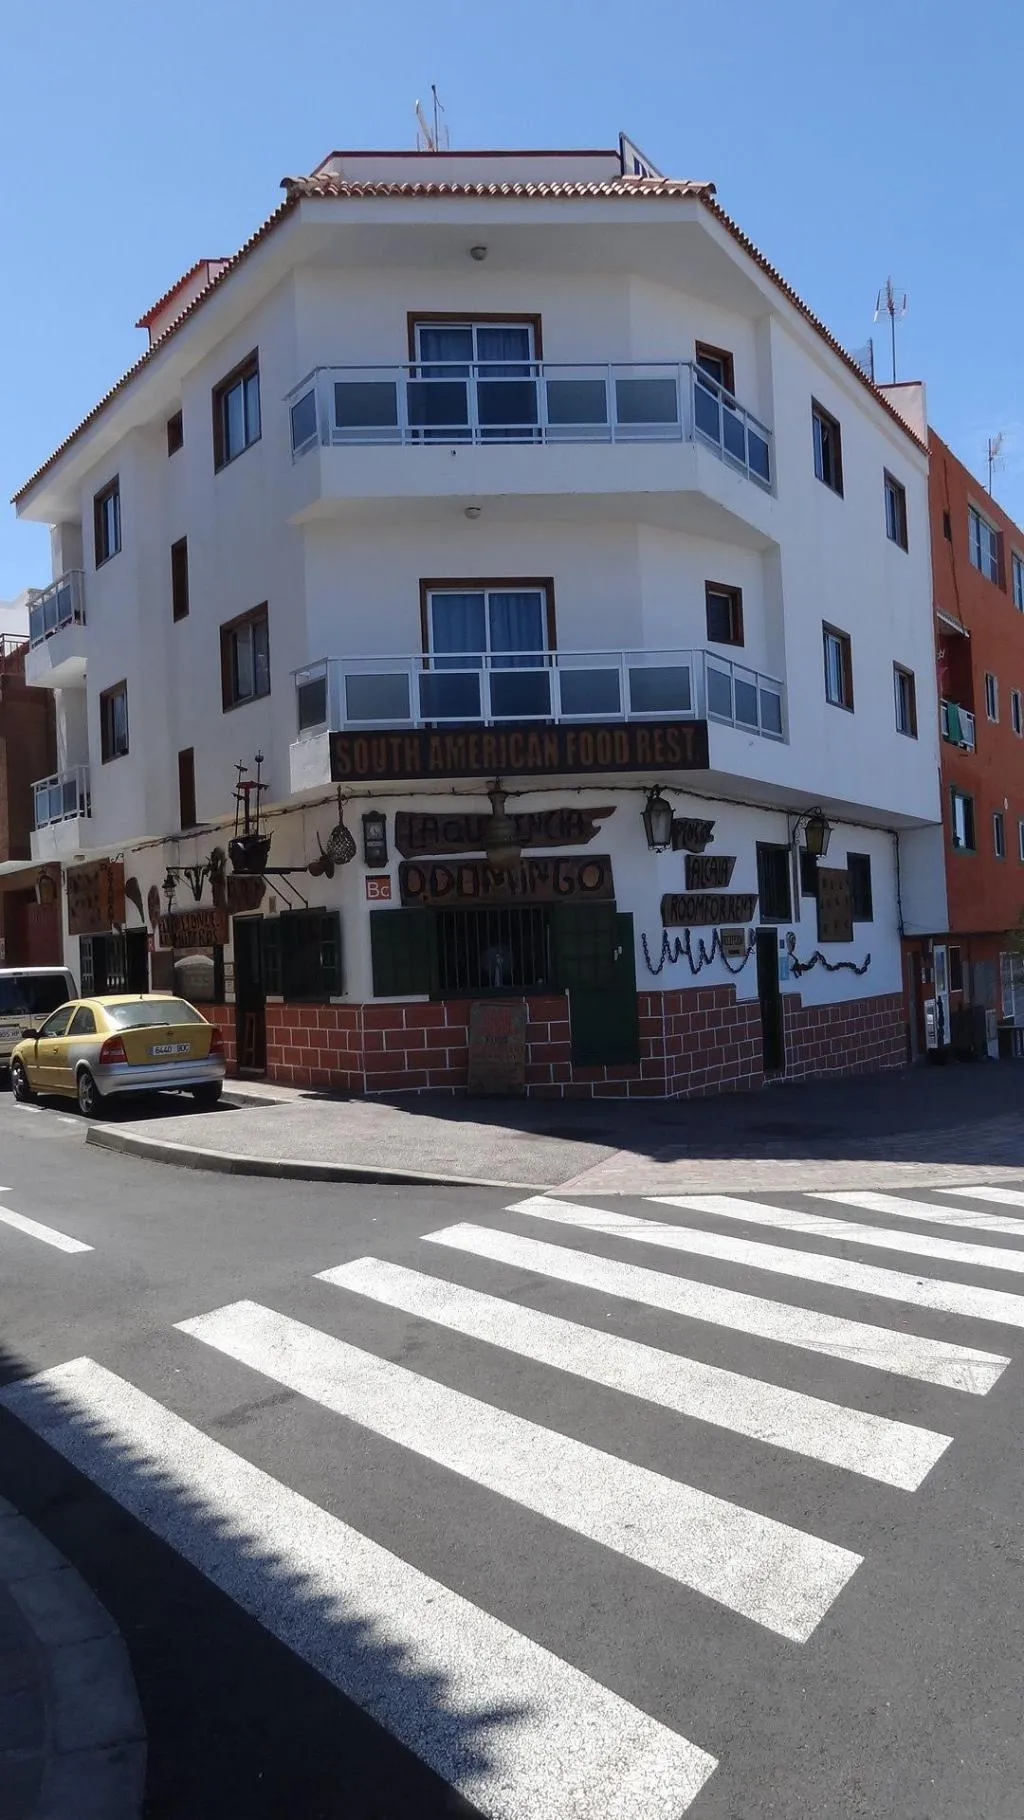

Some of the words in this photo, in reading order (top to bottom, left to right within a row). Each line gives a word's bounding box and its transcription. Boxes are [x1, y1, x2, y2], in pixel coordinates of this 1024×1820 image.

[338, 736, 420, 774] SOUTH
[430, 729, 559, 769] AMERICAN
[567, 726, 629, 766] FOOD
